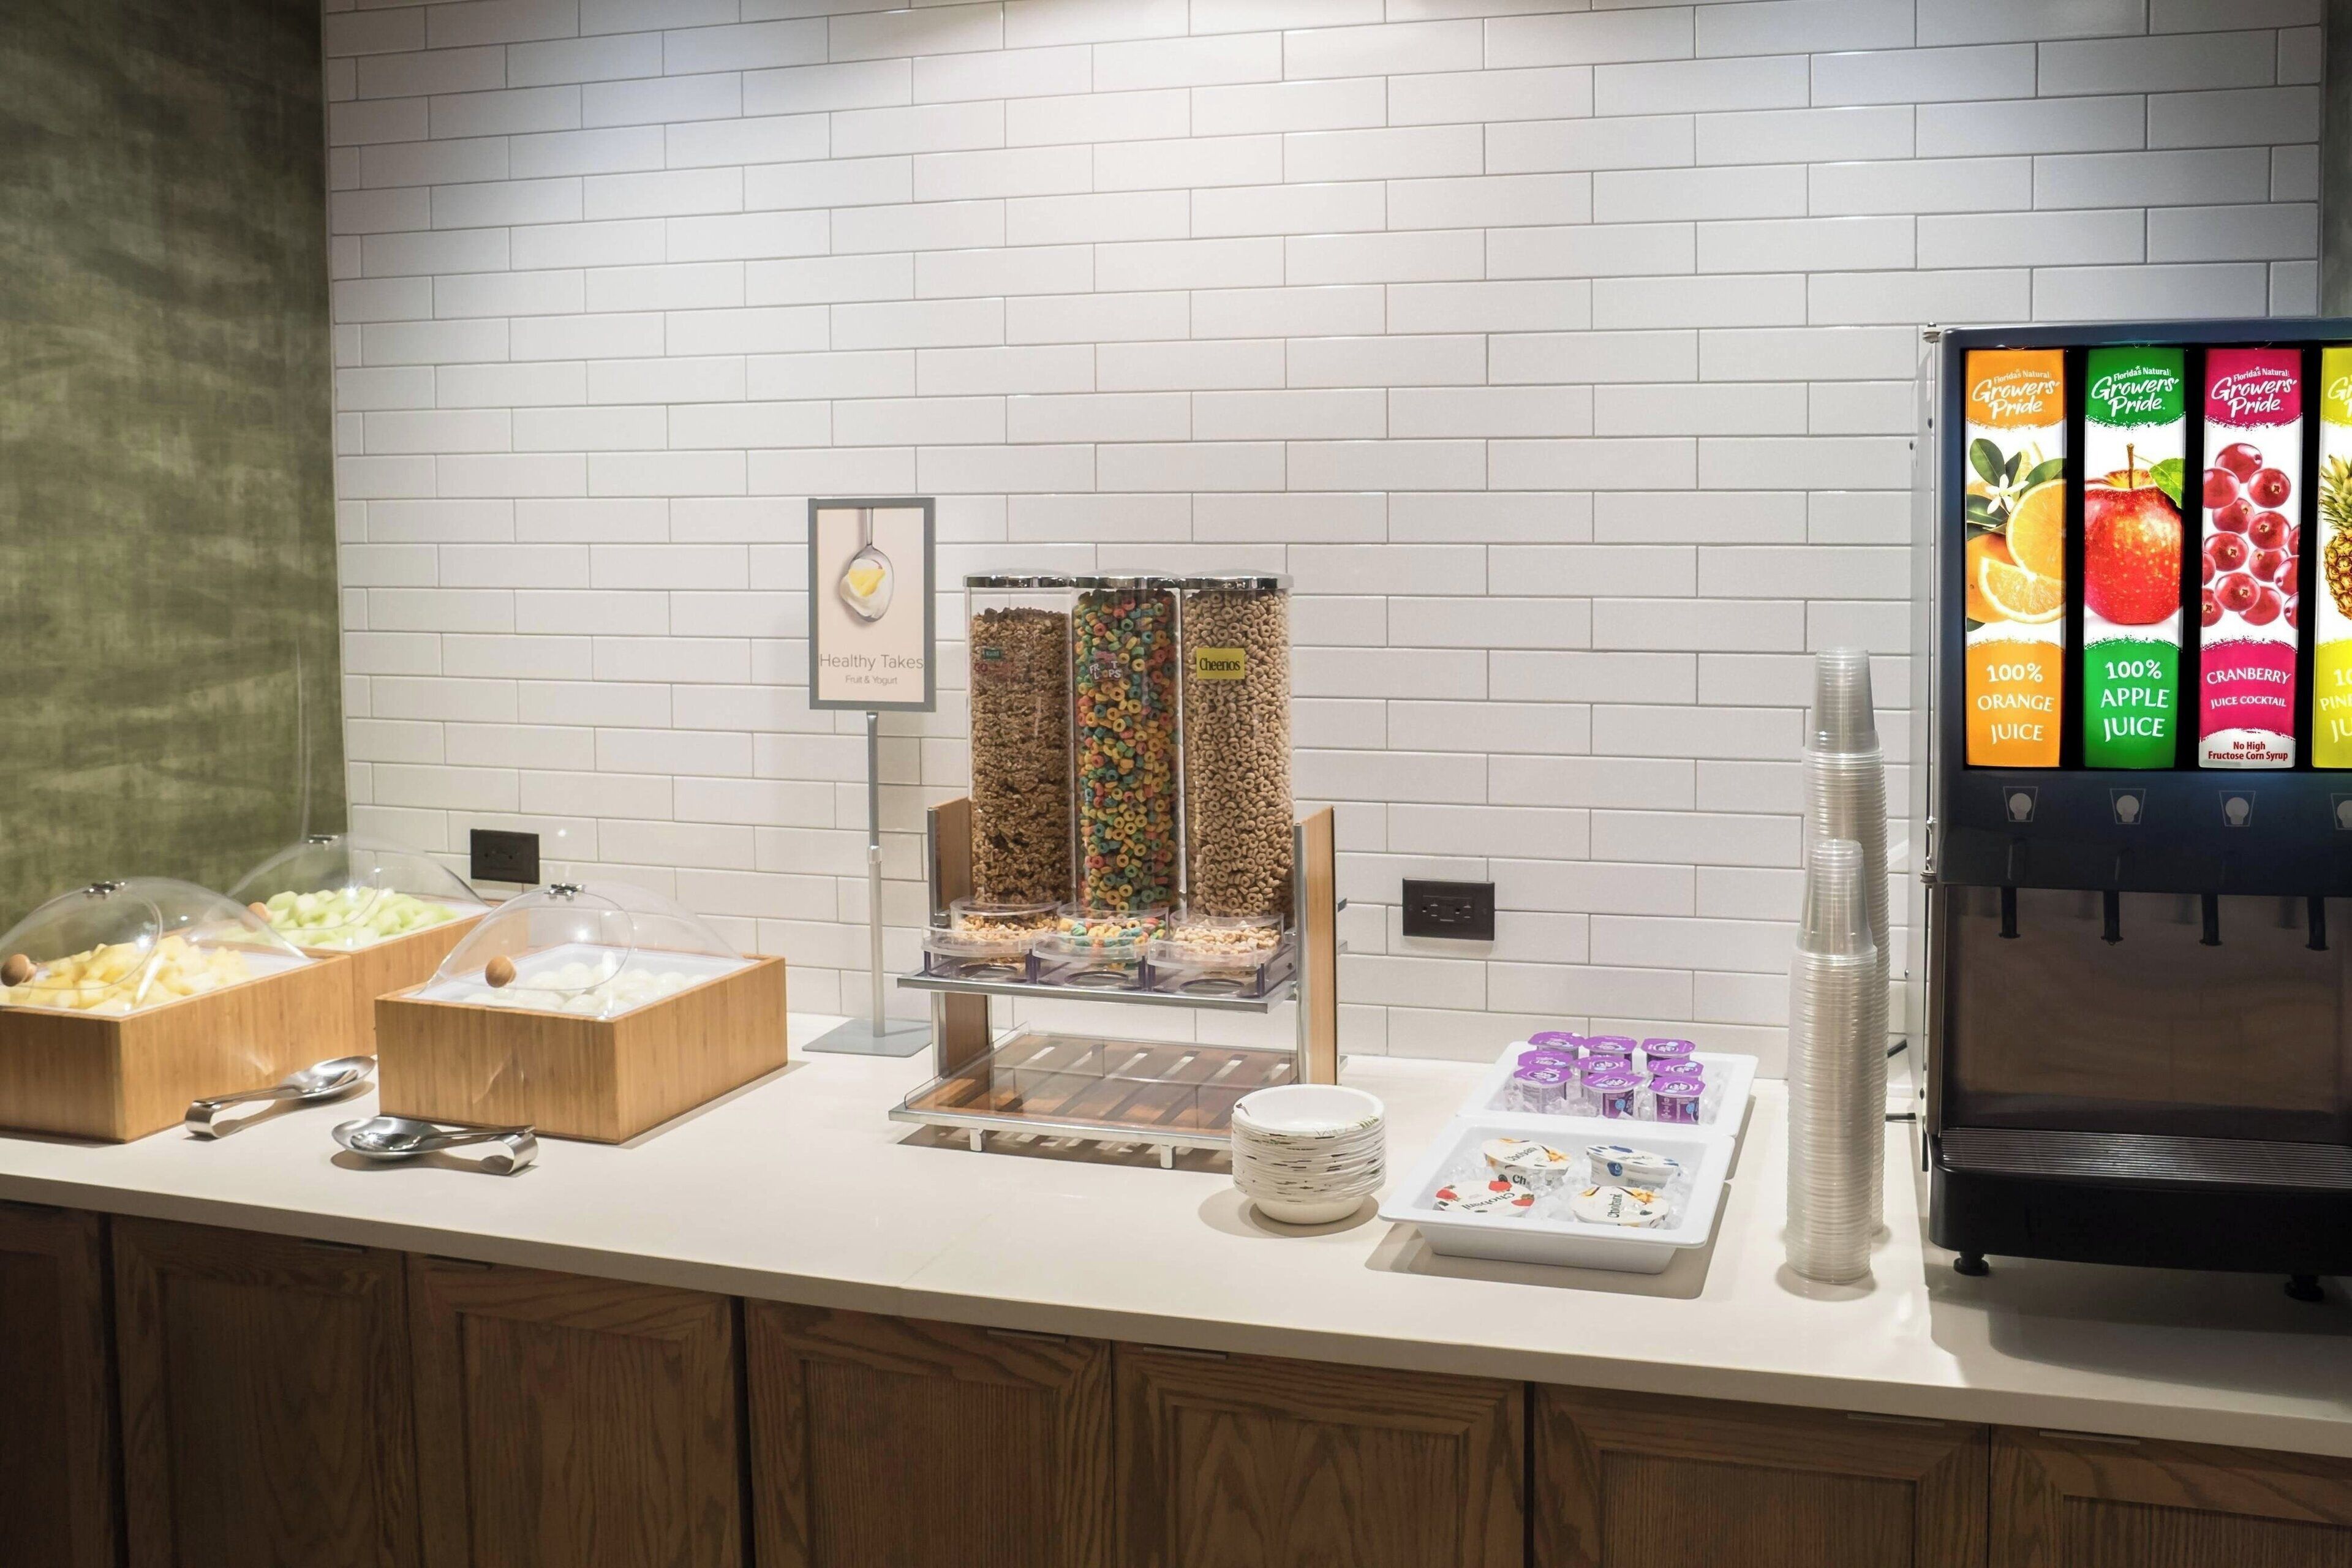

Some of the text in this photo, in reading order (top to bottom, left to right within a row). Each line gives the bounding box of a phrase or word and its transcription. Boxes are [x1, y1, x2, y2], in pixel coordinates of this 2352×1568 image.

[2022, 370, 2051, 379] Natural
[2114, 368, 2169, 382] Florida's Natural
[2233, 368, 2288, 382] Florida's Natural
[1972, 379, 2060, 403] Growers'
[2091, 376, 2180, 401] Growers'
[2211, 377, 2297, 401] Growers'
[1989, 395, 2043, 420] Pride
[2228, 393, 2281, 418] Pride
[820, 654, 924, 671] Healthy Takes
[2105, 659, 2162, 679] 100%
[845, 675, 897, 686] Fruit & Yogurt
[1986, 663, 2043, 682] 100%
[2206, 668, 2291, 685] CRANBERRY
[1977, 693, 2054, 712] ORANGE
[2100, 687, 2170, 708] APPLE
[2211, 696, 2286, 709] JUICE COCKTAIL
[1991, 723, 2044, 745] JUICE
[2103, 717, 2165, 742] JUICE
[2233, 741, 2266, 752] No High
[2208, 751, 2244, 760] Fructose
[2266, 751, 2288, 762] Syrup
